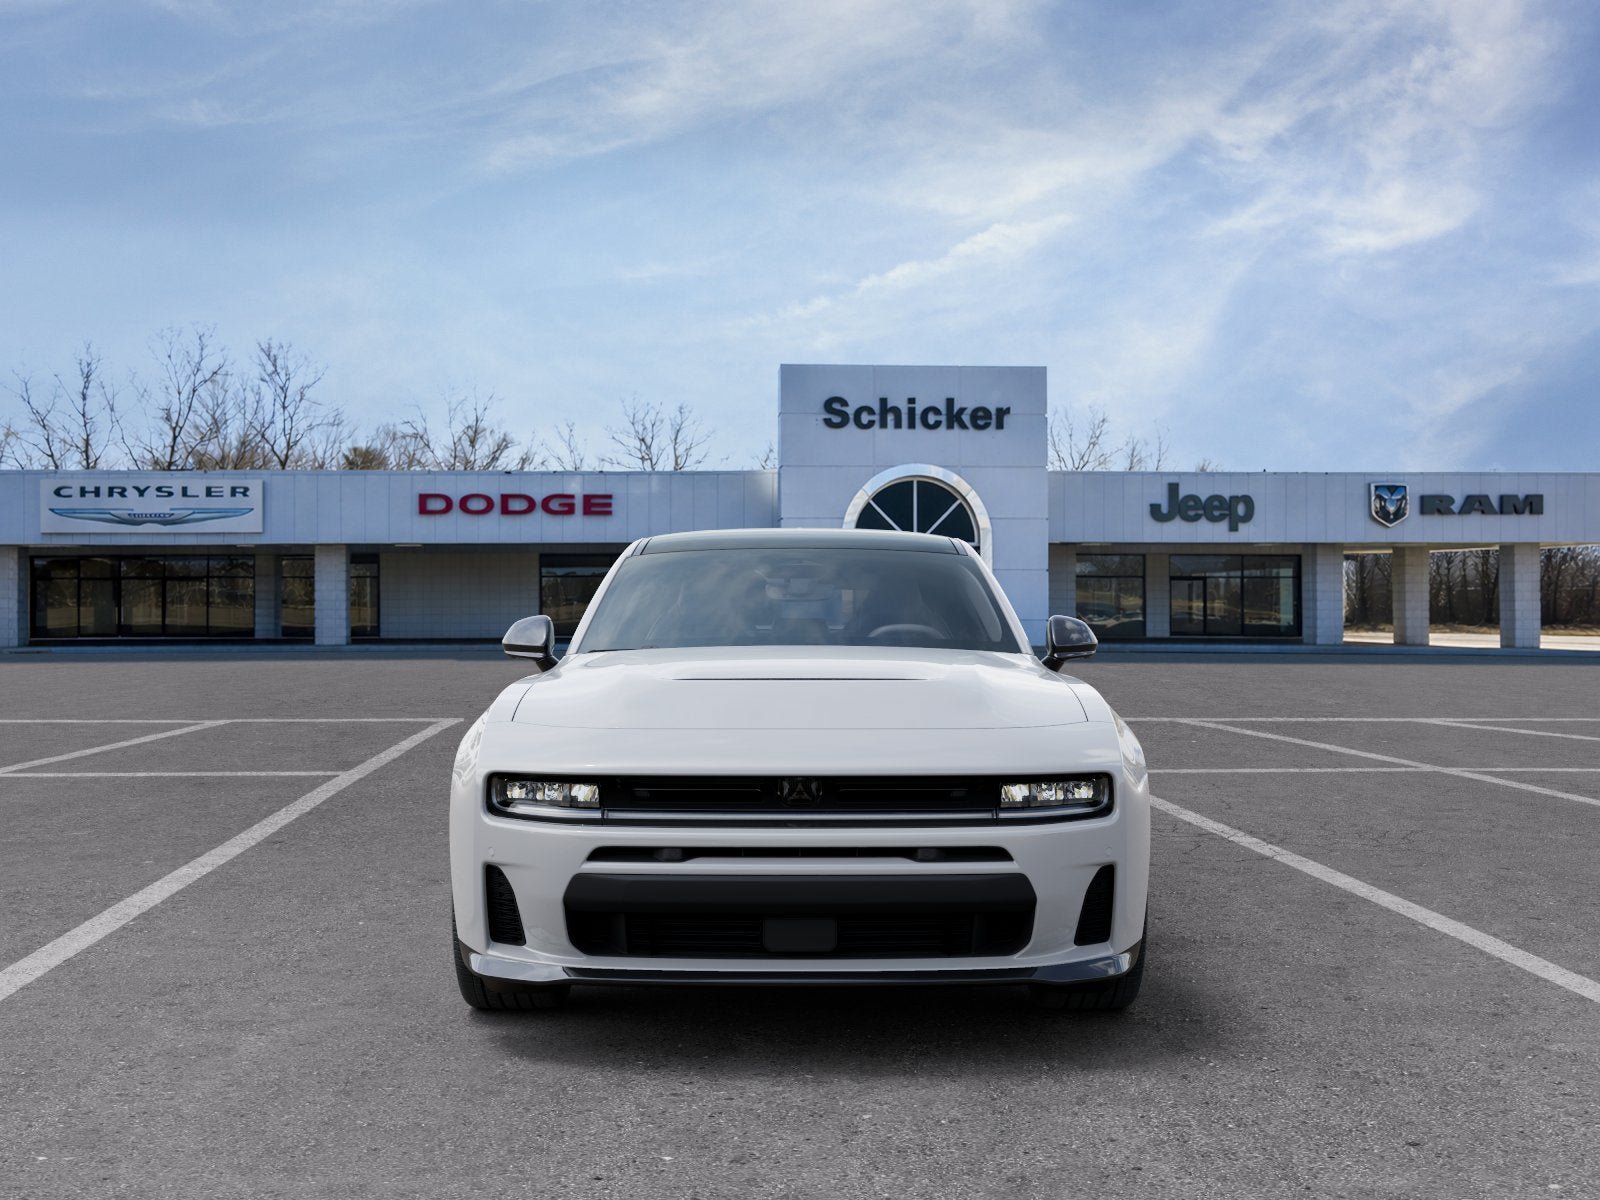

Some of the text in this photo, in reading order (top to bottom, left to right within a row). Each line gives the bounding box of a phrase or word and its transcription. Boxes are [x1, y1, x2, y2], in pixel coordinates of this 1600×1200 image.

[823, 396, 1011, 430] Schicker
[53, 485, 250, 498] CHRYSLER
[418, 493, 613, 516] DODGE
[1149, 482, 1255, 532] Jeep
[1420, 494, 1544, 516] RAM
